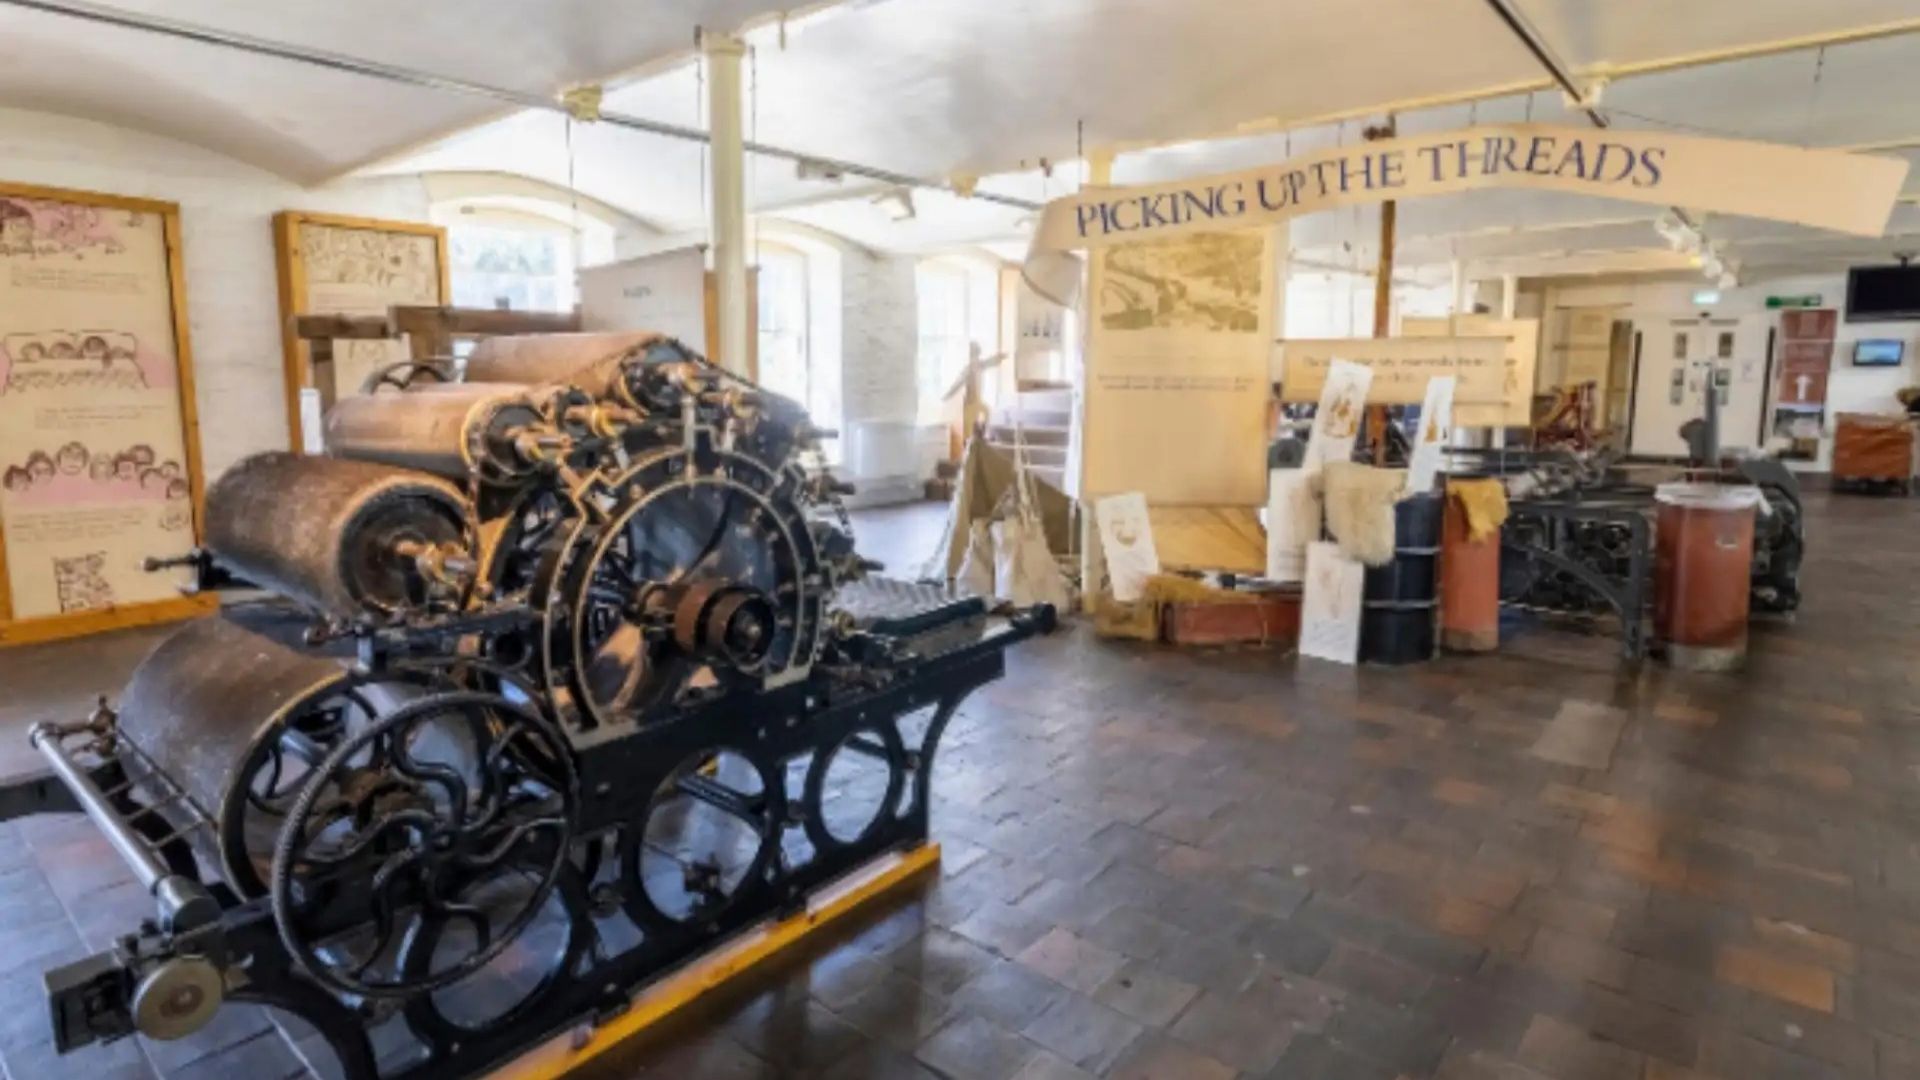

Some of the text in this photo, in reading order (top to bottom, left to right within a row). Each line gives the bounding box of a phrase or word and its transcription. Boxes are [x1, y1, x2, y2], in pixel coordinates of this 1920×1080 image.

[1076, 136, 1665, 237] PICKING UP THE THREADS
